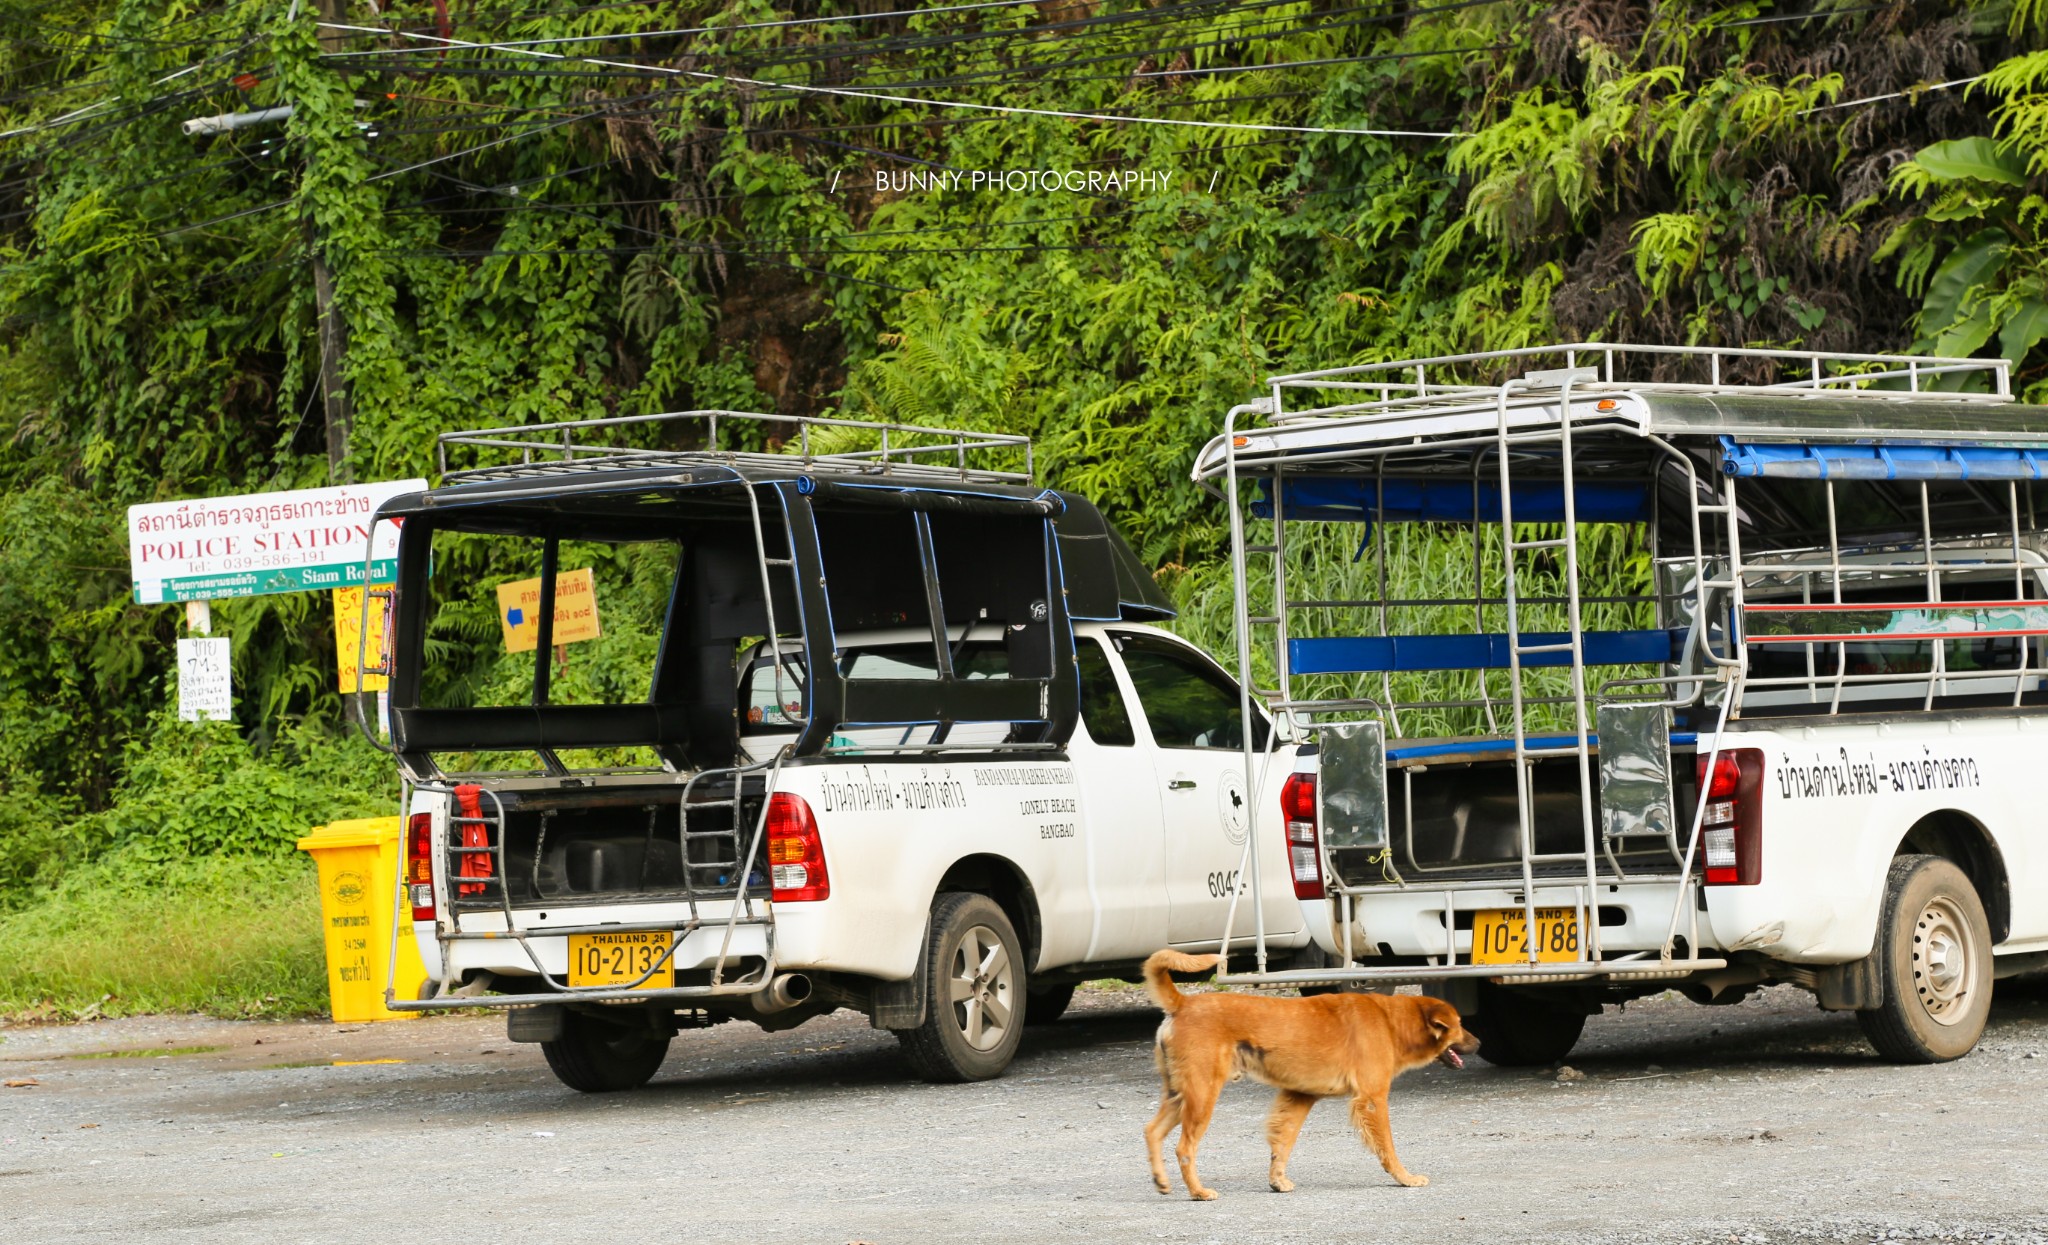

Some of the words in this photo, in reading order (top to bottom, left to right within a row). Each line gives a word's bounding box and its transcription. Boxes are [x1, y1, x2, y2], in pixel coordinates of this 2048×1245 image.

[140, 536, 241, 562] POLICE
[253, 523, 371, 553] STATION
[223, 550, 327, 570] 039-586-191
[302, 569, 339, 585] Siam
[1019, 799, 1049, 816] LONELY
[1050, 798, 1076, 813] BEACH
[1040, 823, 1075, 840] BANGBAO
[1501, 910, 1562, 921] THAAND
[591, 934, 648, 945] THAILAND
[654, 934, 665, 944] 26
[578, 945, 666, 976] 10-2132
